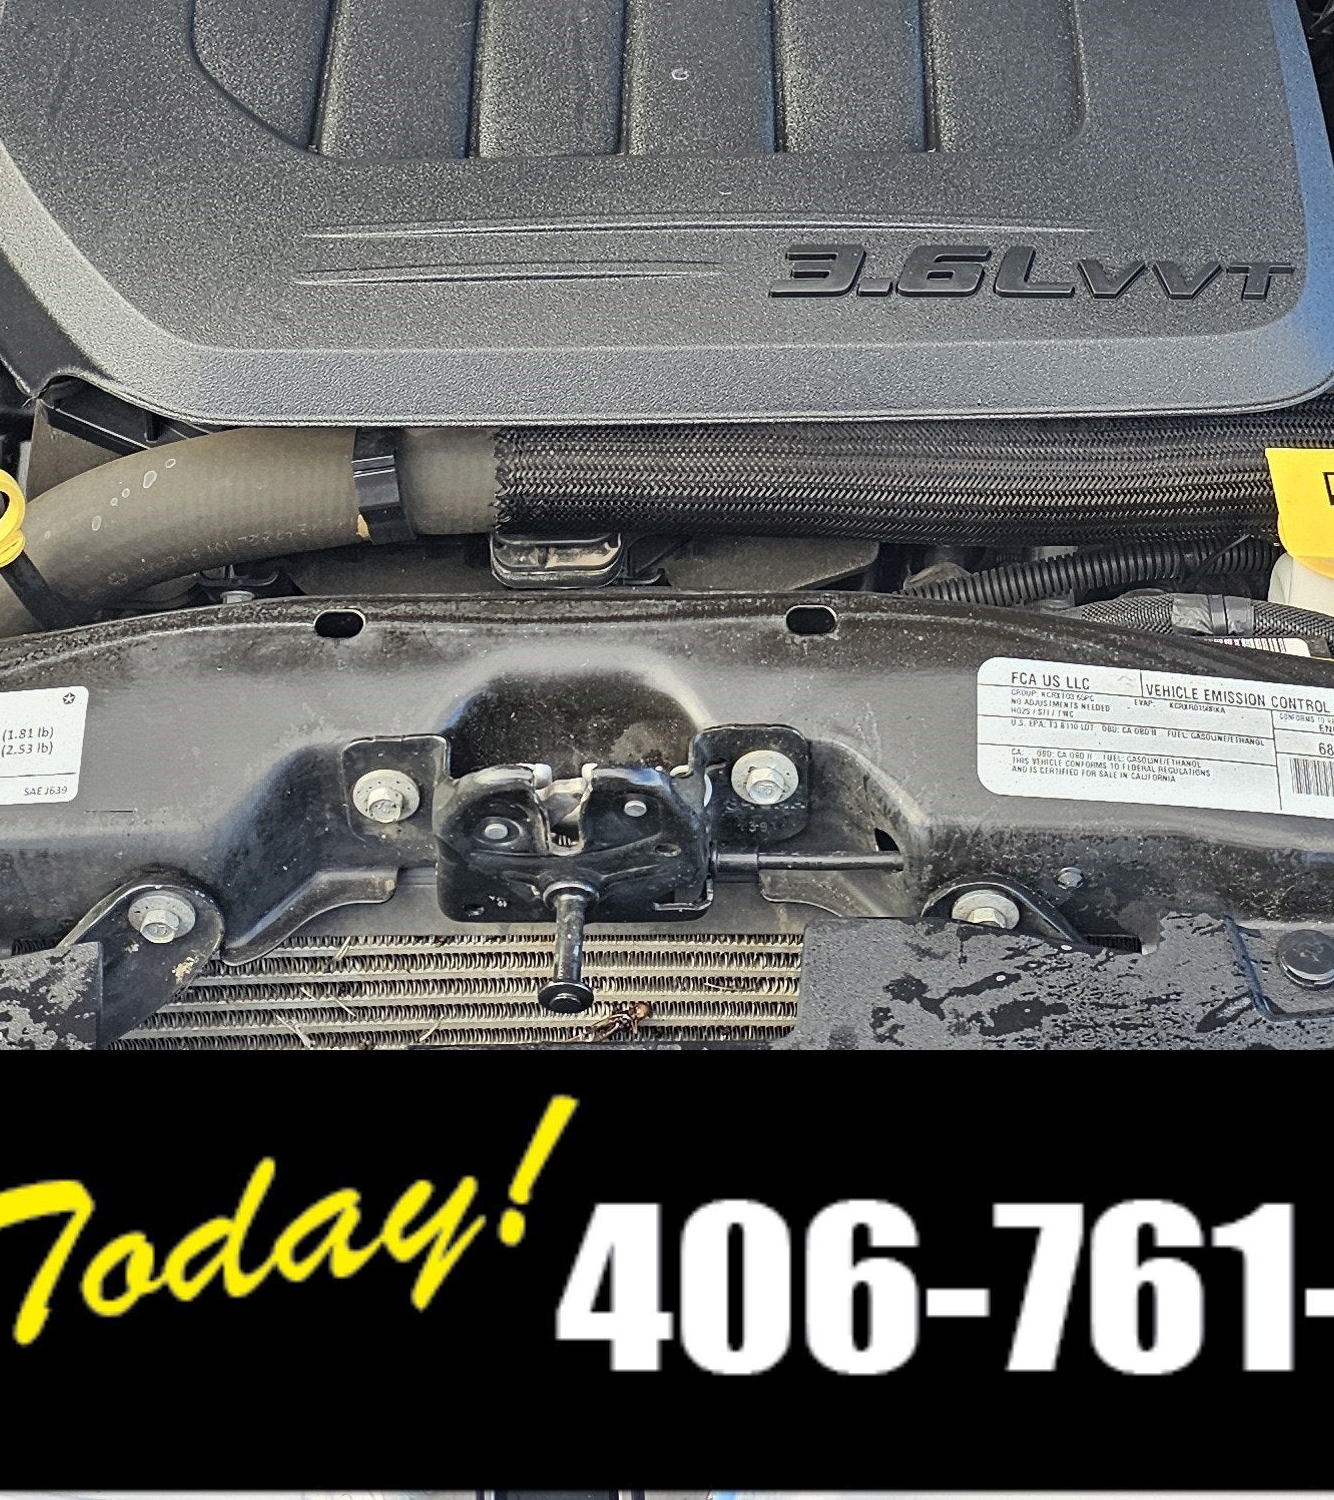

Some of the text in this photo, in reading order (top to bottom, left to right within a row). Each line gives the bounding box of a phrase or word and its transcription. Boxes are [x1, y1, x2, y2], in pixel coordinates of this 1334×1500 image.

[1011, 671, 1090, 690] FCA US LLC
[1024, 699, 1079, 709] ADJUSTMENTS
[1081, 703, 1111, 712] NEEDED
[1146, 683, 1197, 699] VEHICLE
[1205, 690, 1266, 707] EMISSION
[1271, 696, 1330, 713] CONTROL
[2, 728, 34, 742] (1.81
[37, 726, 54, 739] lb)
[1122, 726, 1132, 734] CA
[1, 745, 34, 758] (2.53
[37, 741, 53, 755] lb)
[1057, 751, 1067, 759] CA
[1012, 757, 1211, 777] THIS VEHICLE CONFORMS TO FEDERAL REGULATIONS
[1012, 765, 1028, 773] AND
[1040, 767, 1079, 777] CERTIFIED
[1081, 769, 1097, 778] FOR
[1099, 770, 1118, 779] SALE
[1119, 772, 1128, 780] IN
[1131, 772, 1176, 783] CALIFORNIA
[24, 787, 42, 796] SAE
